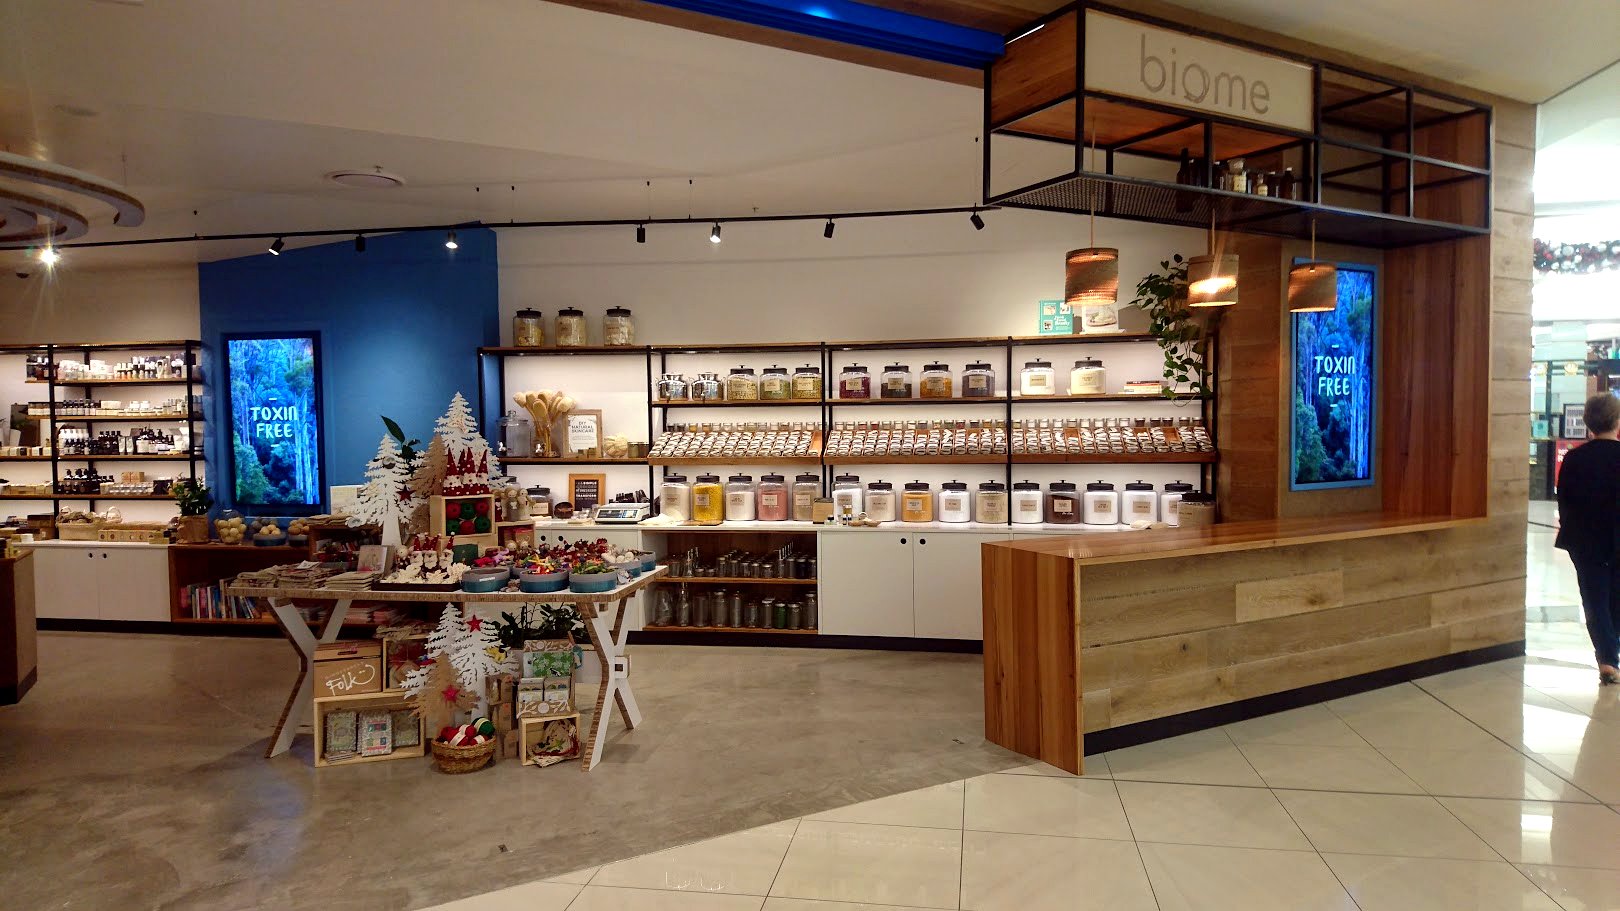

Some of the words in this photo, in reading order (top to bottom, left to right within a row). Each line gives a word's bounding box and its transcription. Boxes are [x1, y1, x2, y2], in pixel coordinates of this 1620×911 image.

[1140, 33, 1270, 114] biome
[1315, 356, 1355, 374] TOXIN
[1318, 377, 1350, 396] FREE
[250, 406, 298, 421] TOXIN
[256, 422, 293, 439] FREE
